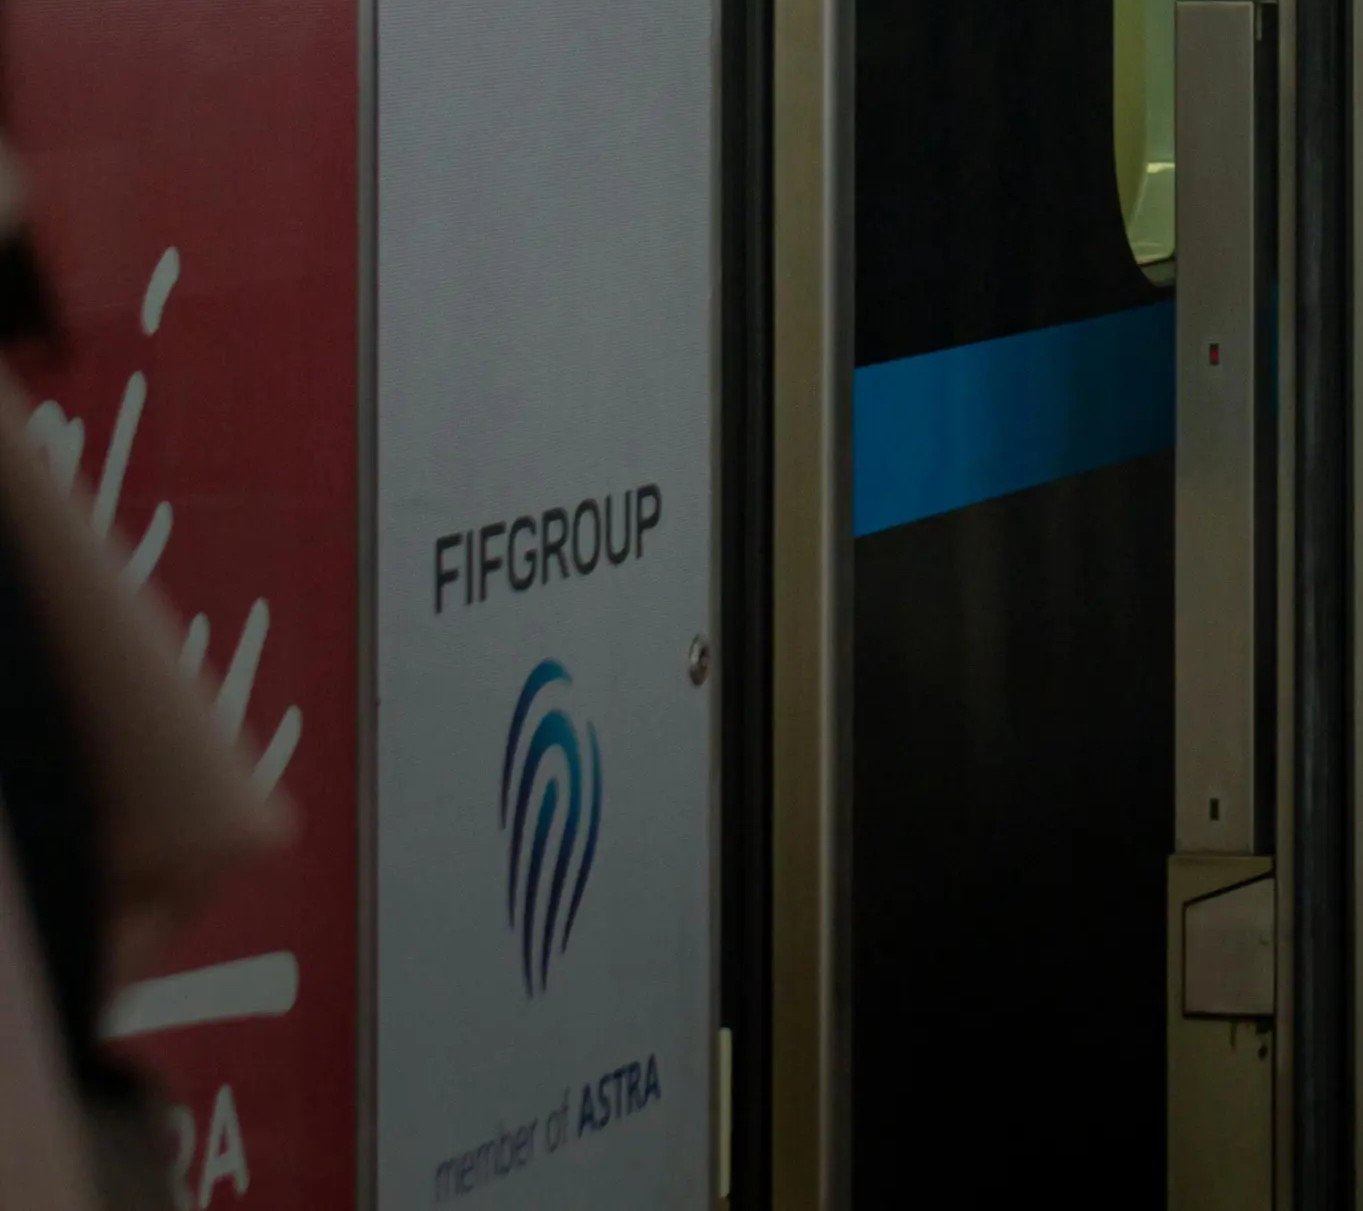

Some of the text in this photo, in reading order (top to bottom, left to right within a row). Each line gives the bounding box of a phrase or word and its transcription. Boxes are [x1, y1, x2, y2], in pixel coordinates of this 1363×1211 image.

[433, 482, 662, 615] FIFGROUP
[434, 1053, 661, 1203] member of ASTRA
